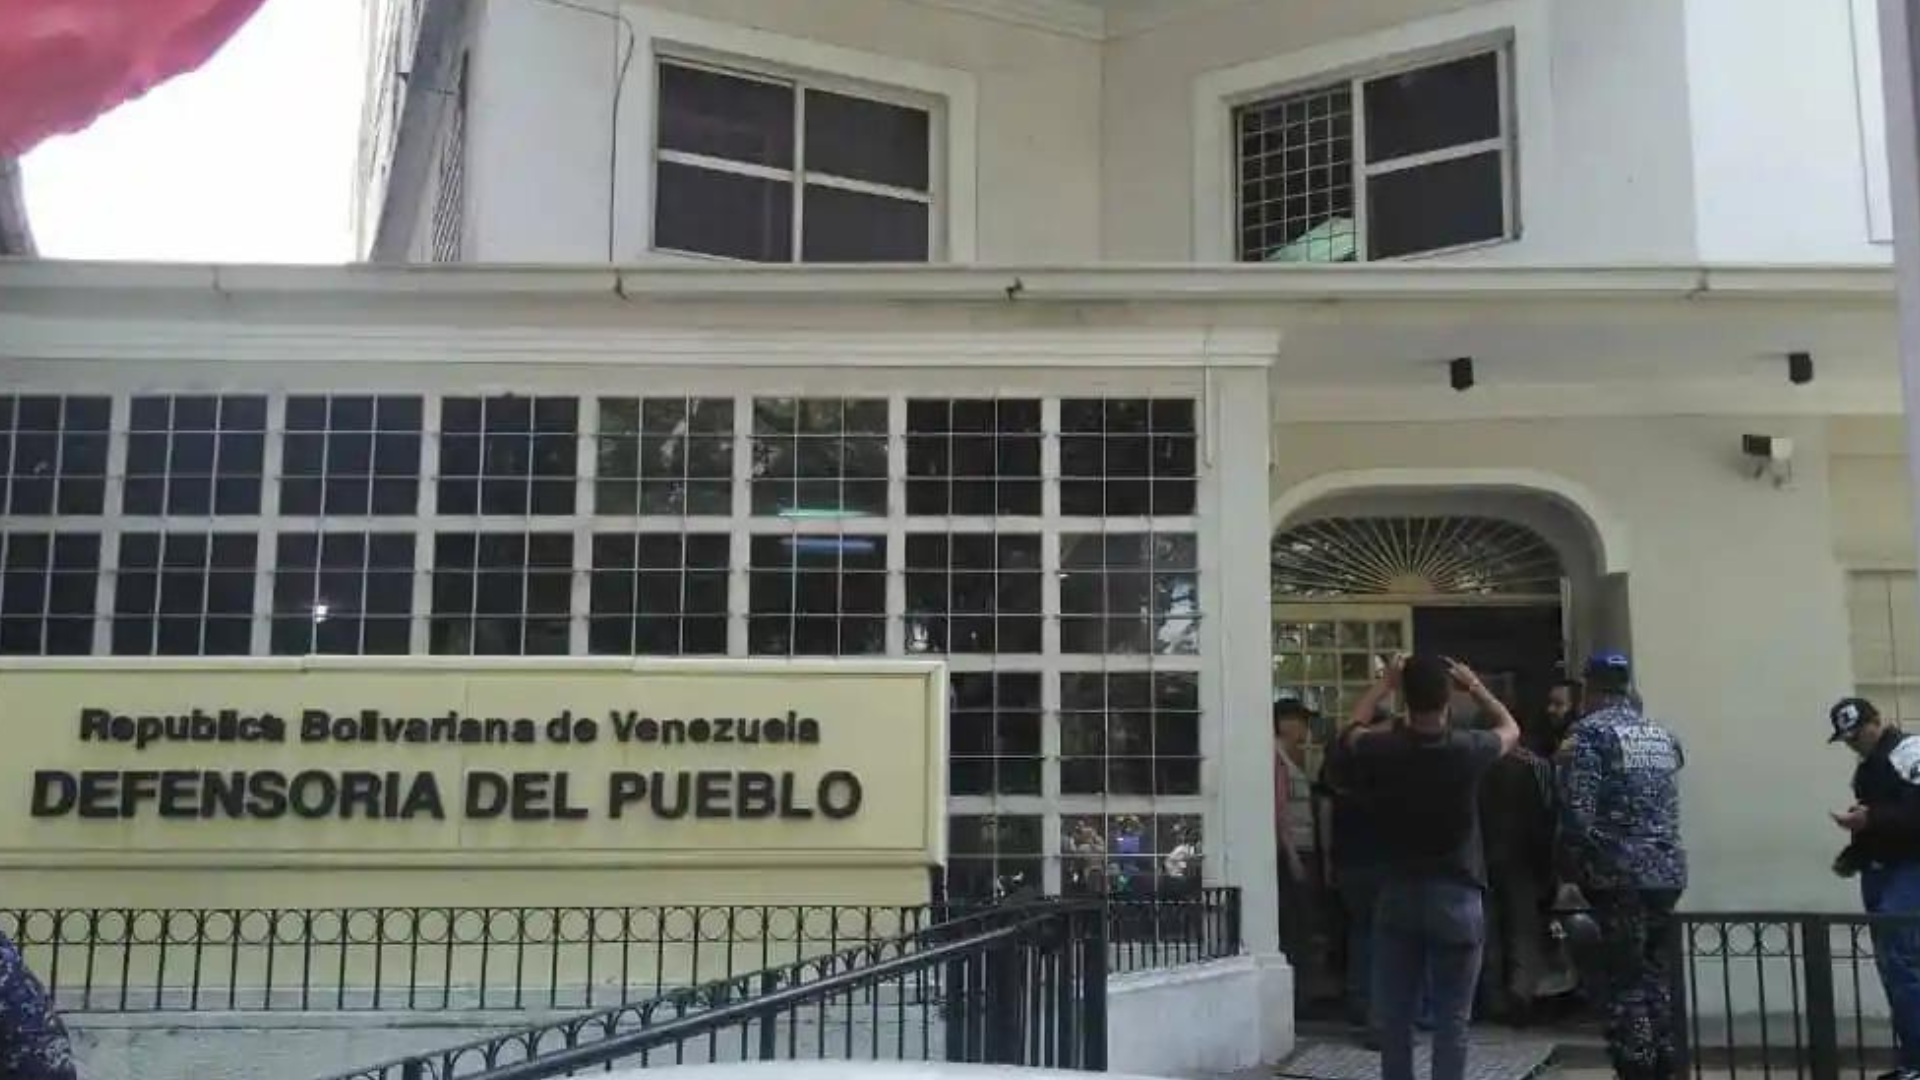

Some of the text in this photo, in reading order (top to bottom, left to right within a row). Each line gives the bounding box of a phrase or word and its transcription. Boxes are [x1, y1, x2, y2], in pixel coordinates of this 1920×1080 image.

[301, 710, 534, 743] Bolivariana
[547, 711, 598, 743] de
[610, 711, 819, 744] Venezuela
[31, 770, 863, 820] DEFENSORIA DEL PUEBLO
